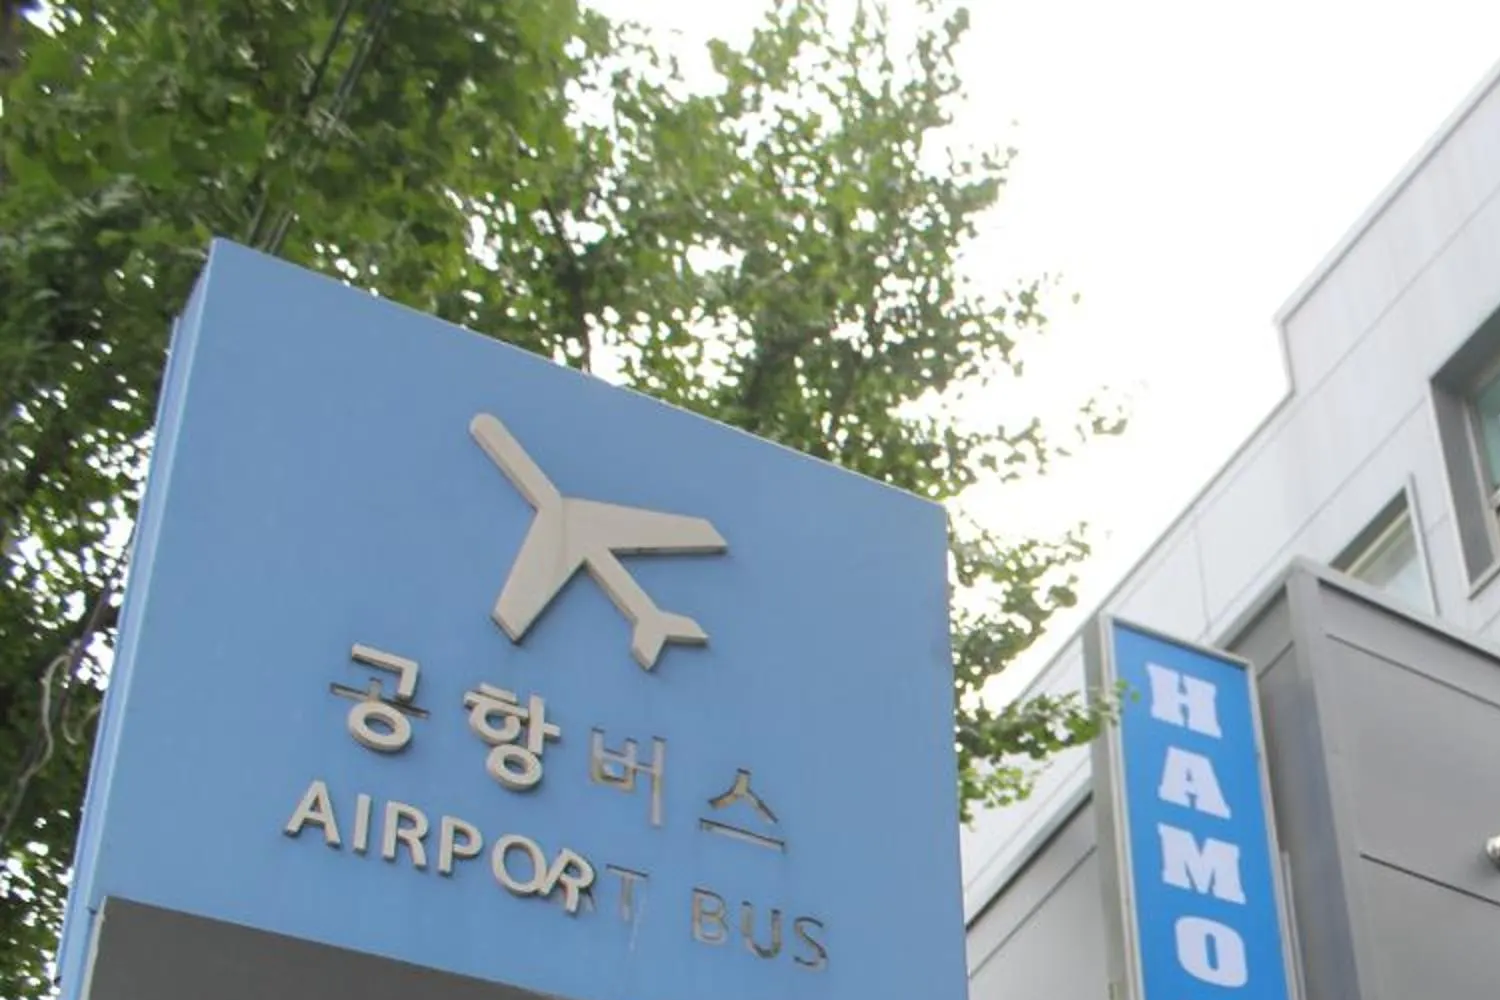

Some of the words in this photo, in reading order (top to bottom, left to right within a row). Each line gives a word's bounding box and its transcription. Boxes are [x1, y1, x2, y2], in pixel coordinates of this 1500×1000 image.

[329, 642, 786, 852] 공항버스
[283, 779, 650, 925] AIRPORT
[692, 888, 829, 970] BUS
